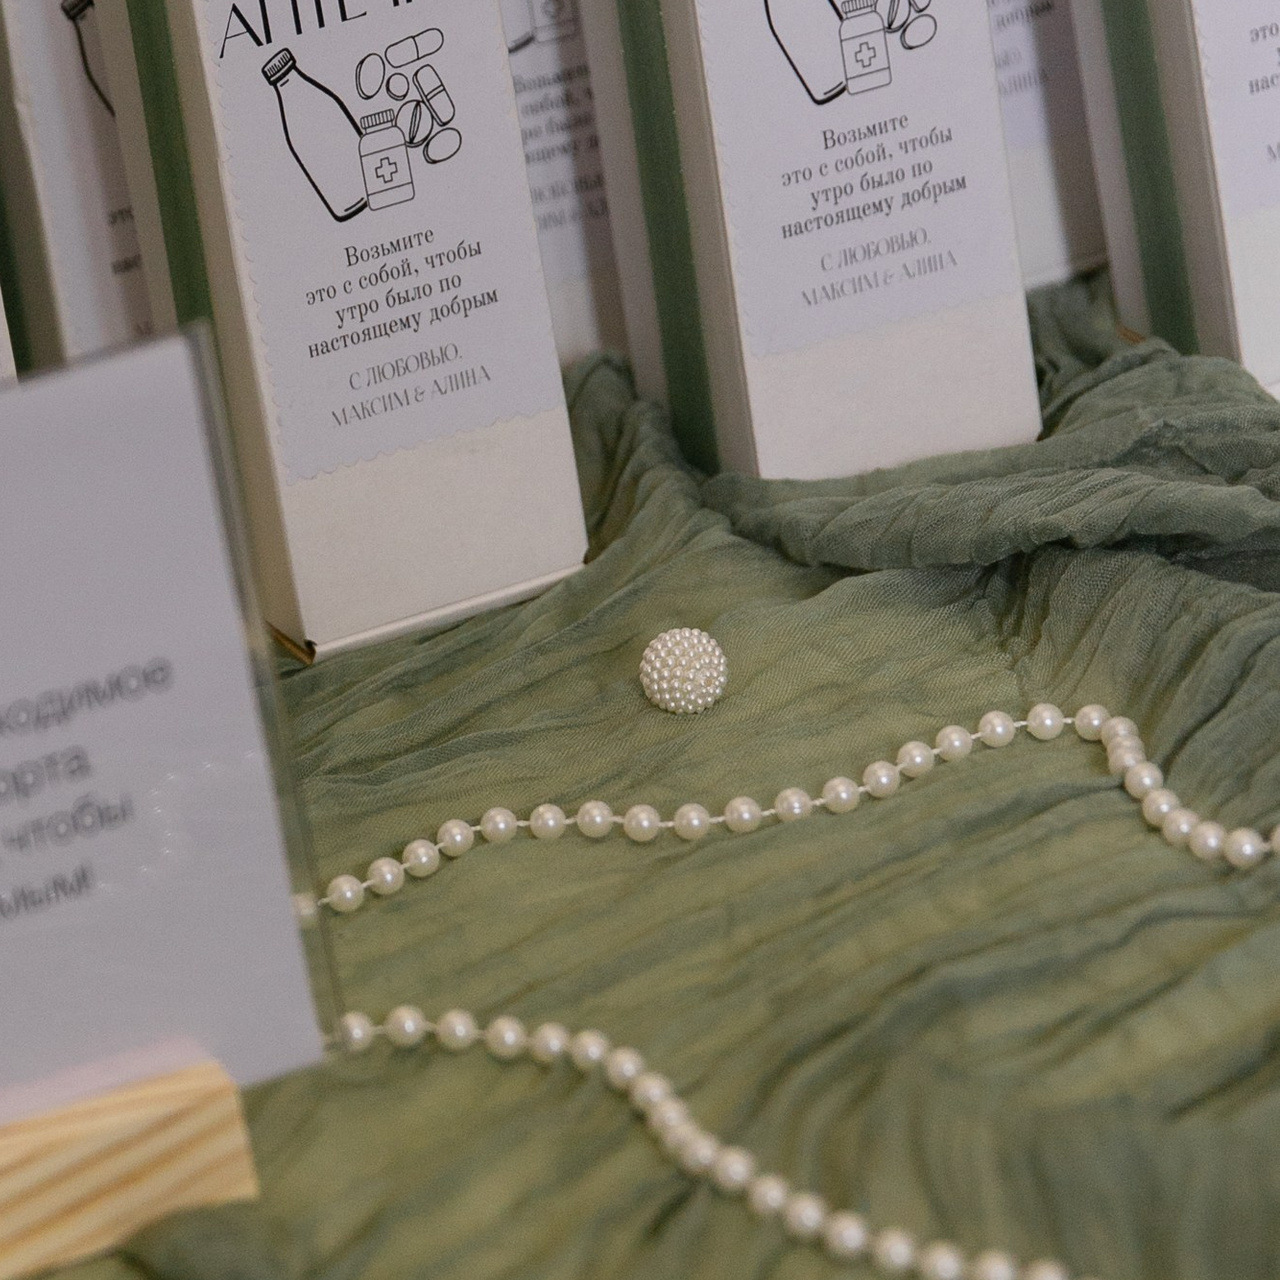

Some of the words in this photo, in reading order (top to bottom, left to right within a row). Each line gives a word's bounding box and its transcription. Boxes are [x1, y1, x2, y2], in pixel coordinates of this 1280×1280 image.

[780, 167, 813, 187] это
[833, 142, 893, 173] собой,
[897, 125, 953, 154] чтобы
[821, 114, 908, 150] Возьмите
[780, 195, 894, 239] настоящему
[900, 174, 967, 210] добрым
[809, 181, 854, 211] утро
[858, 167, 905, 192] было
[910, 159, 933, 178] по
[305, 284, 337, 305] это
[357, 257, 419, 290] собой,
[423, 239, 482, 269] чтобы
[343, 228, 434, 267] Возьмите
[307, 311, 421, 358] настоящему
[429, 288, 498, 325] добрым
[334, 298, 379, 330] утро
[384, 282, 433, 308] было
[438, 274, 462, 293] по
